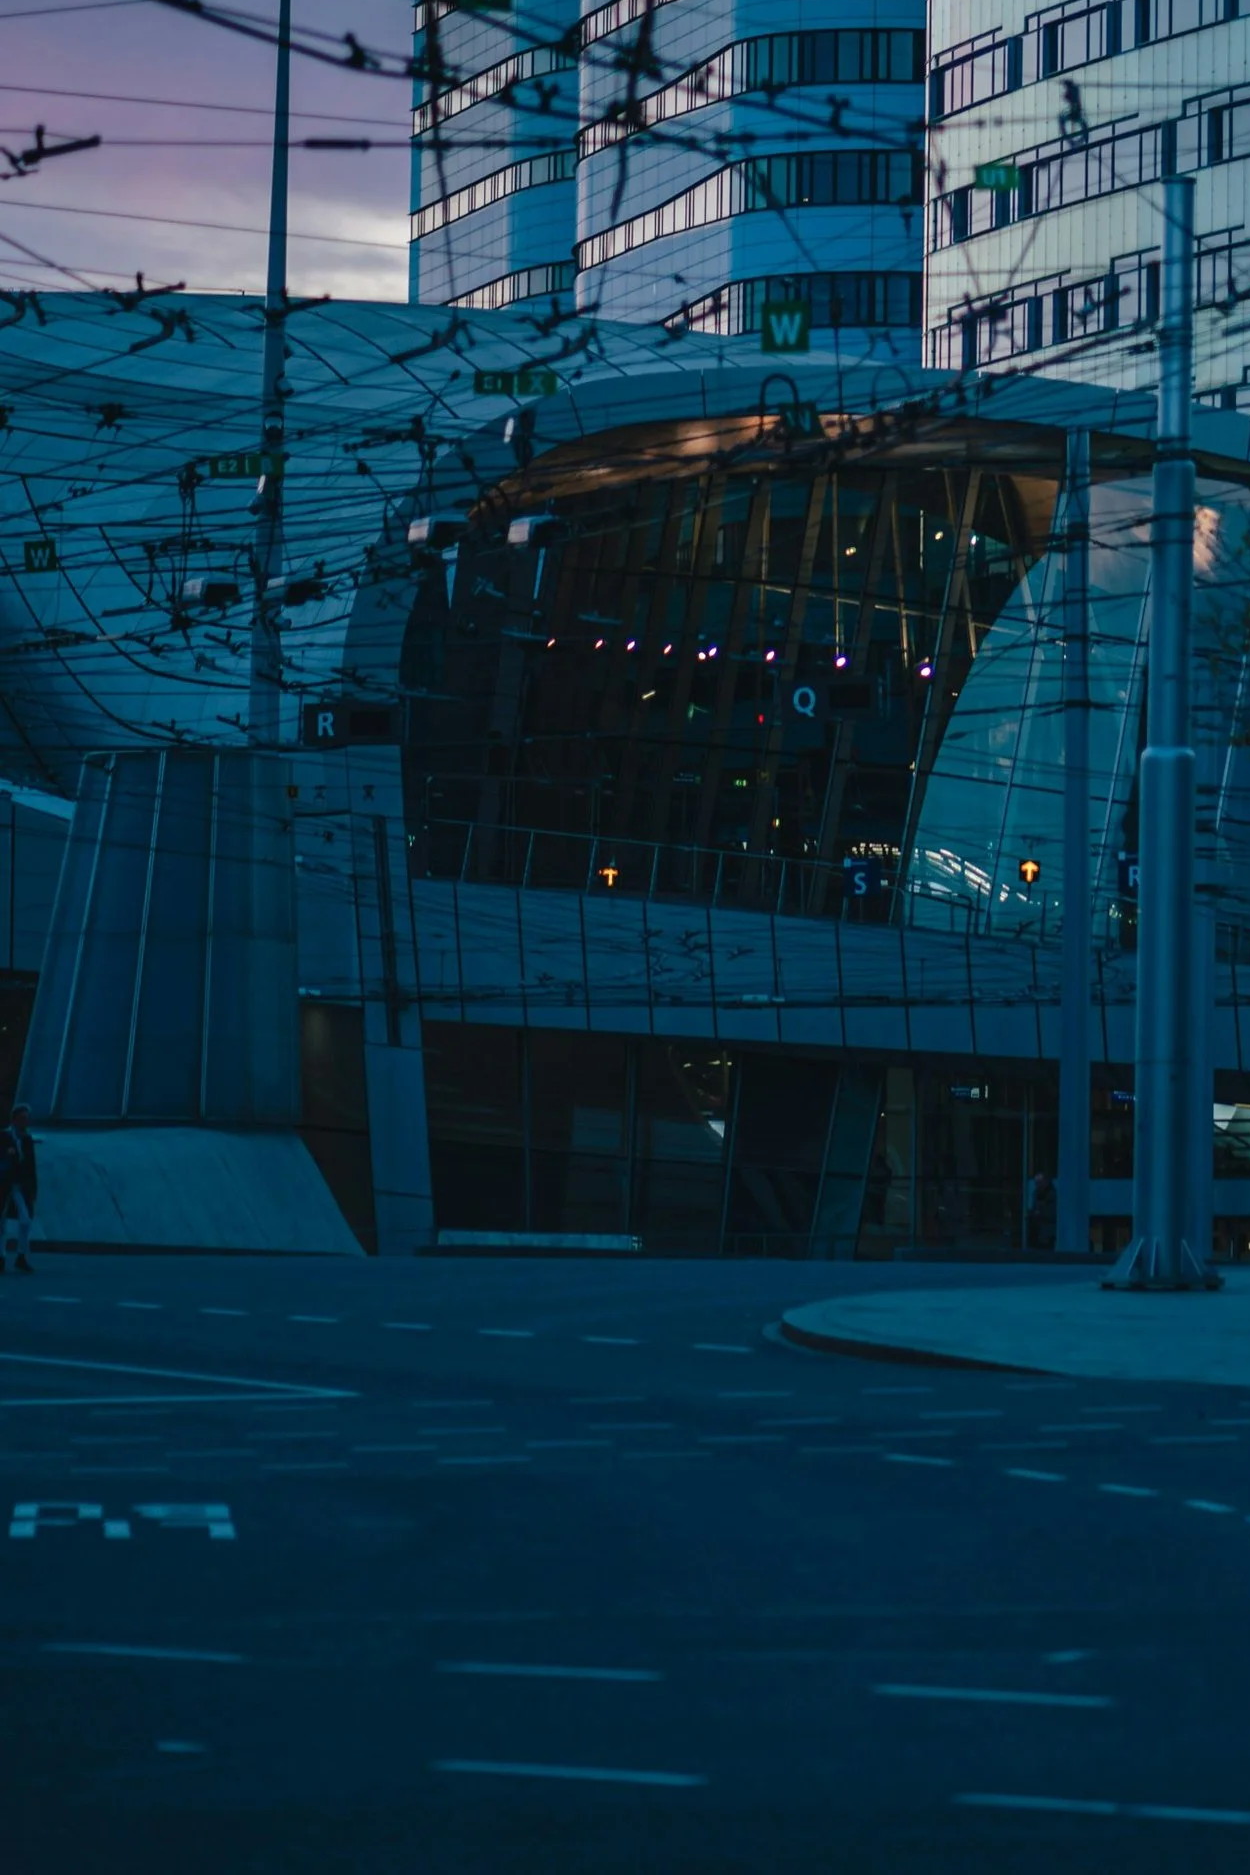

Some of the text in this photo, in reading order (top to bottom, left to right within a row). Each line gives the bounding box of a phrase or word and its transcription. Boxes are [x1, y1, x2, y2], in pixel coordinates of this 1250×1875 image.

[769, 311, 802, 347] W
[217, 459, 239, 474] E2
[30, 547, 51, 569] W
[792, 685, 816, 718] Q
[317, 711, 335, 737] R
[853, 871, 867, 895] S
[1128, 865, 1141, 888] R
